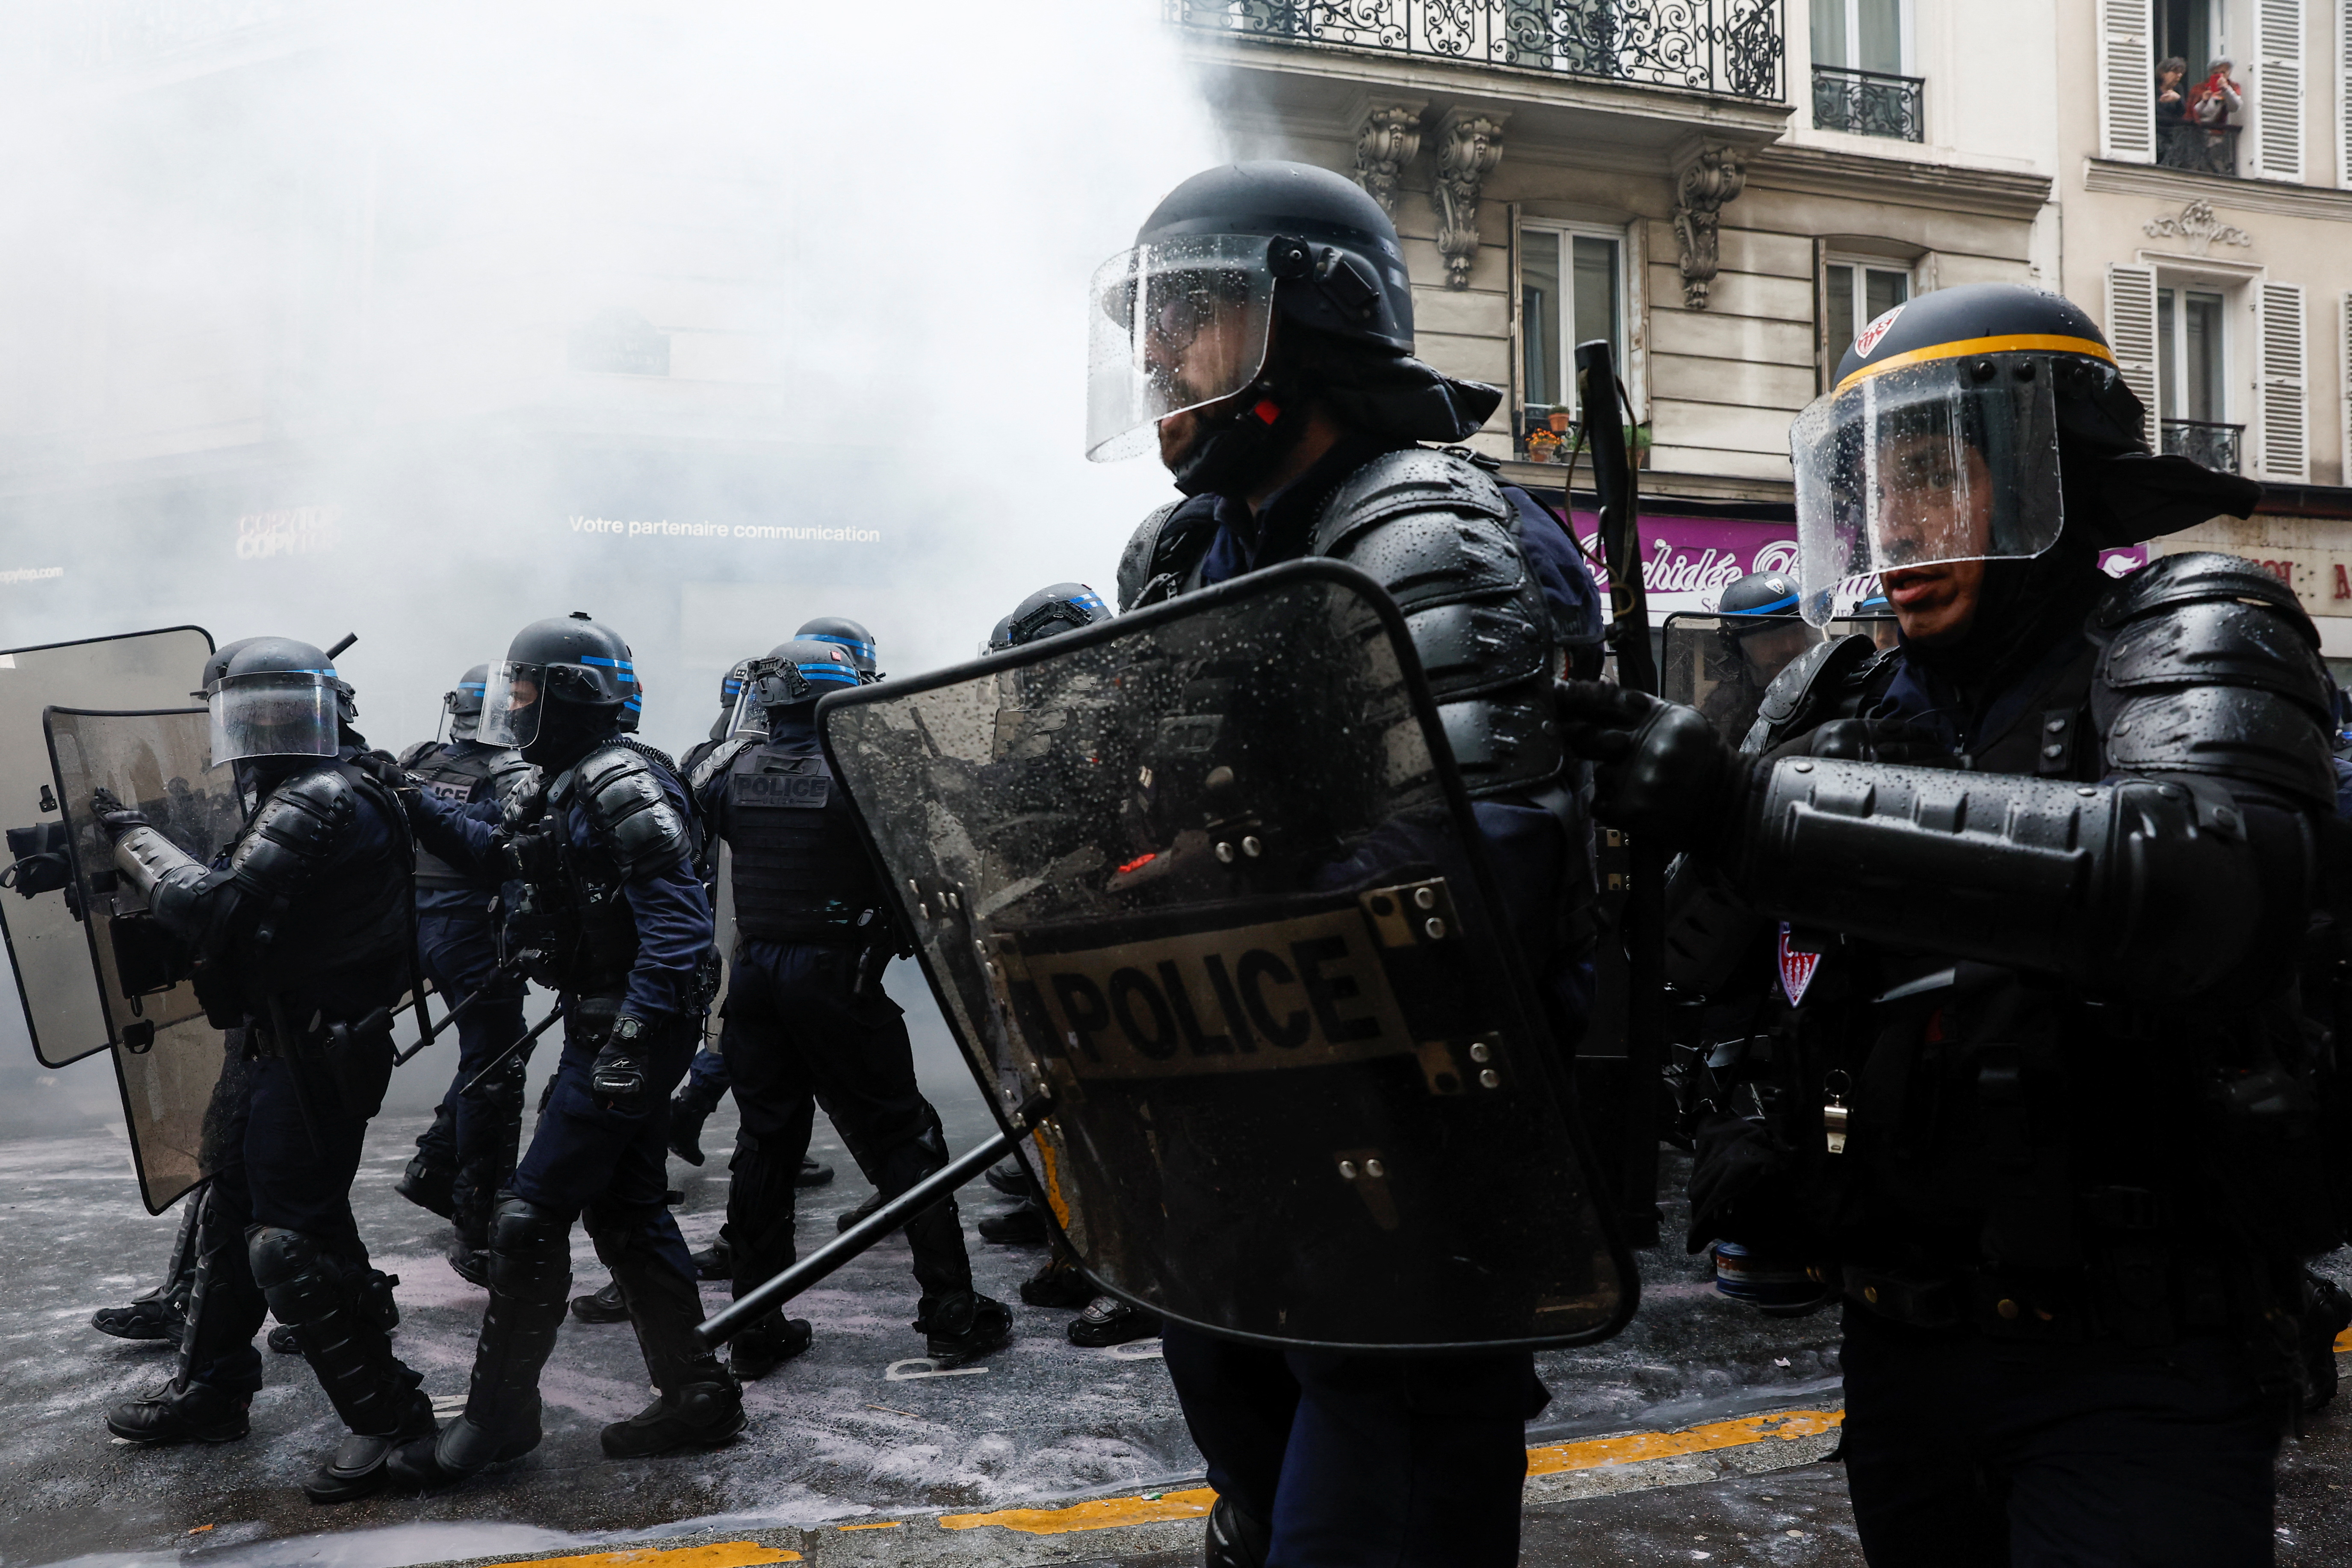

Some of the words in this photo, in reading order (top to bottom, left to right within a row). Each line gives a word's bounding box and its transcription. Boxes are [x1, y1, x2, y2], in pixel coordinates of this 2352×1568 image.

[1859, 320, 1889, 340] CRS
[569, 515, 623, 534] Votre
[628, 518, 729, 538] partenaire
[733, 524, 880, 543] communication
[434, 787, 468, 800] ICE
[736, 777, 827, 797] POLICE
[1050, 934, 1381, 1063] POLICE
